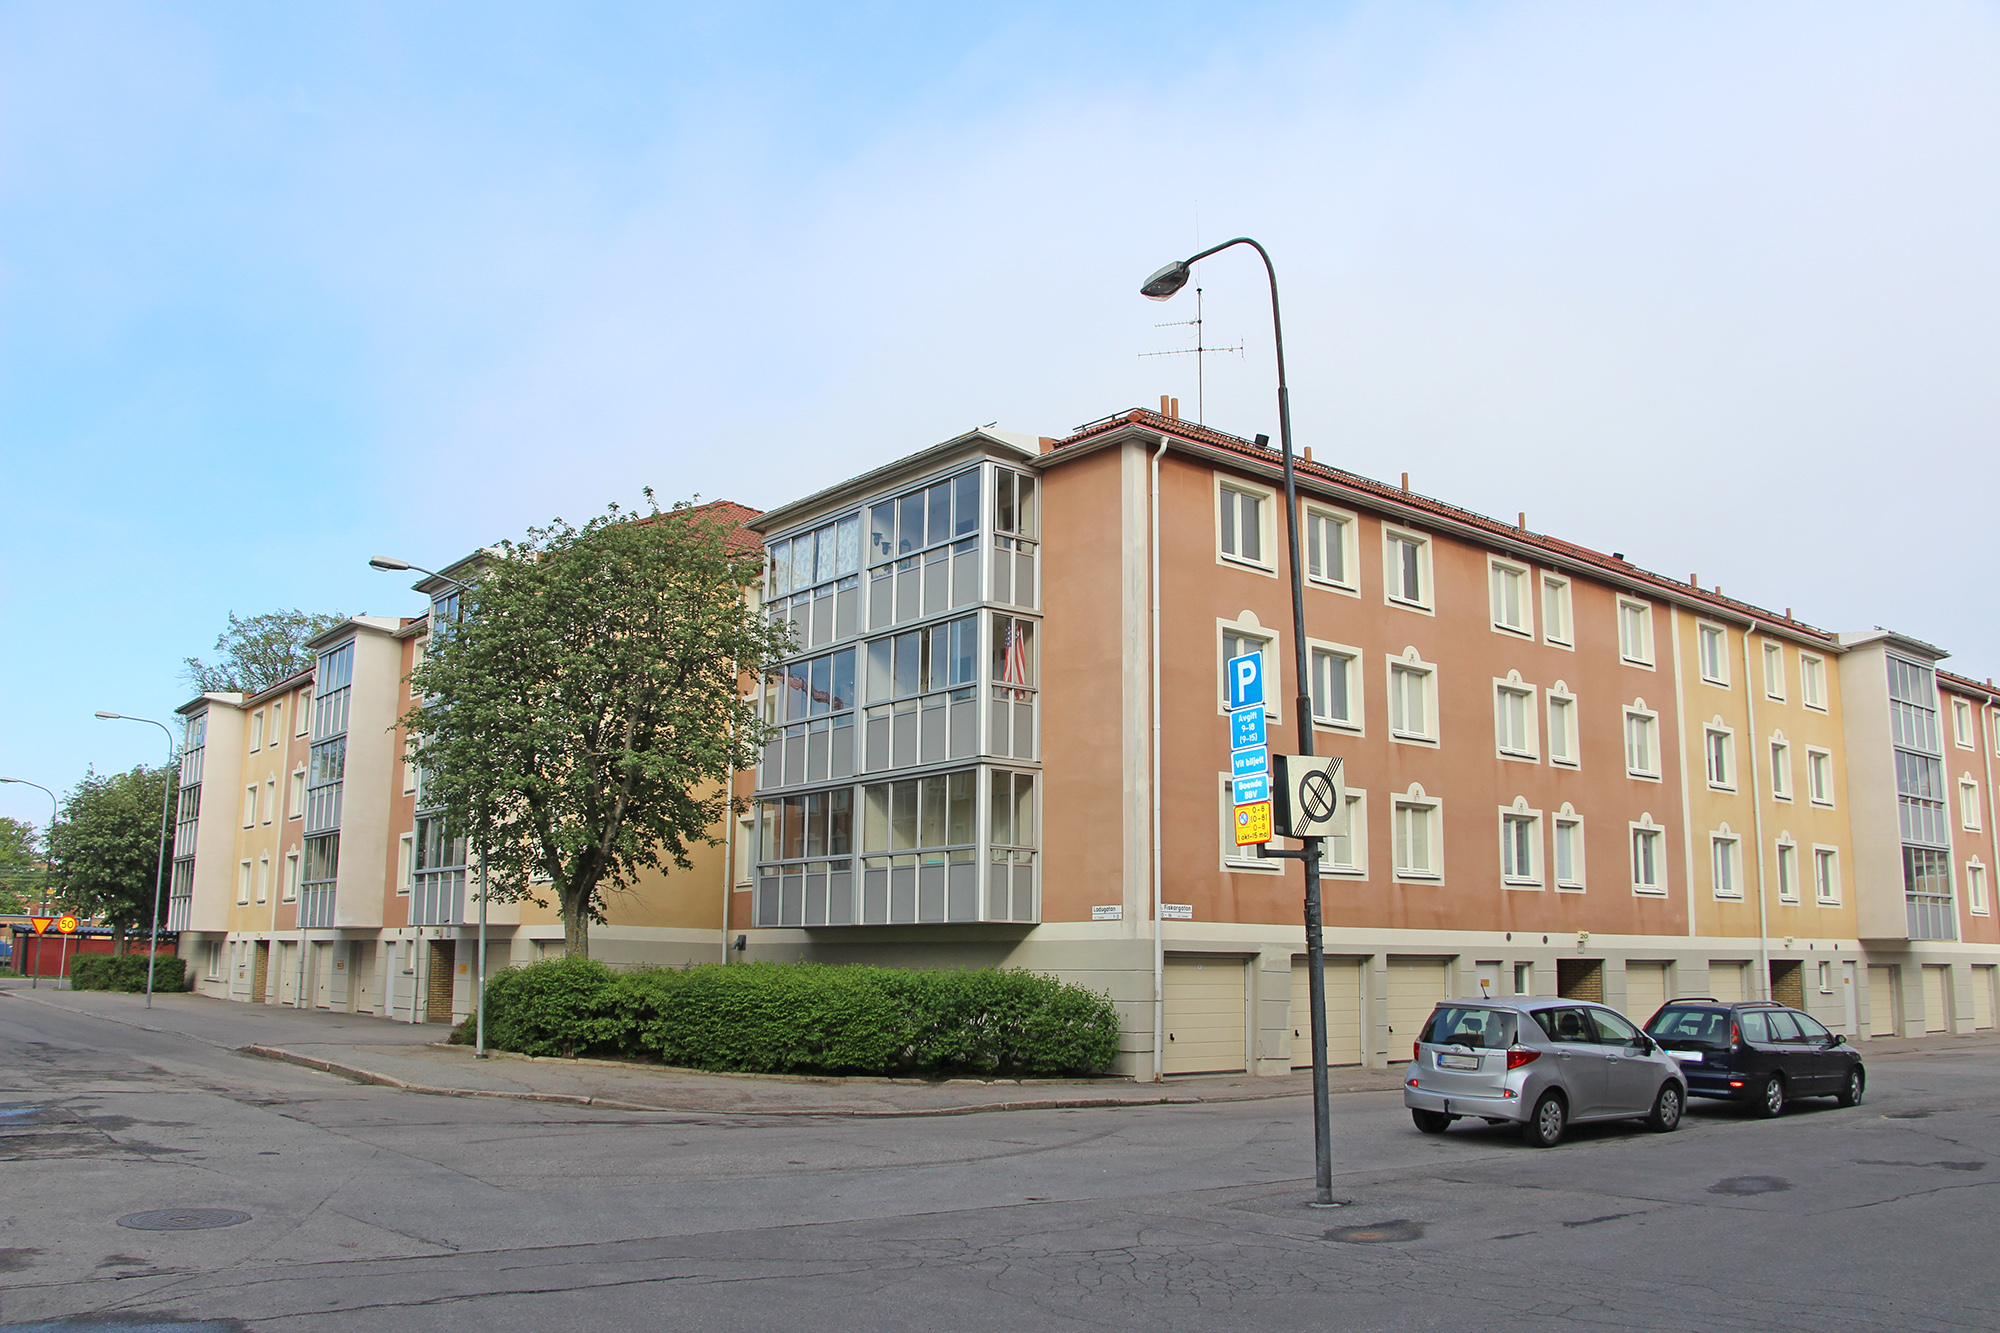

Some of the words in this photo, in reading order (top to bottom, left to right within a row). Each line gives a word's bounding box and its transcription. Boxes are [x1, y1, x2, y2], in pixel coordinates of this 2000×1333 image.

[1237, 660, 1257, 703] P
[1238, 711, 1258, 723] Avgift
[1241, 722, 1255, 732] 9-18
[1239, 732, 1258, 744] (9-15)
[1235, 759, 1245, 768] Vit
[1245, 755, 1265, 767] biljett
[1238, 779, 1262, 791] Boende
[1244, 789, 1258, 800] BBV
[1259, 830, 1269, 838] maj
[61, 920, 74, 928] 50
